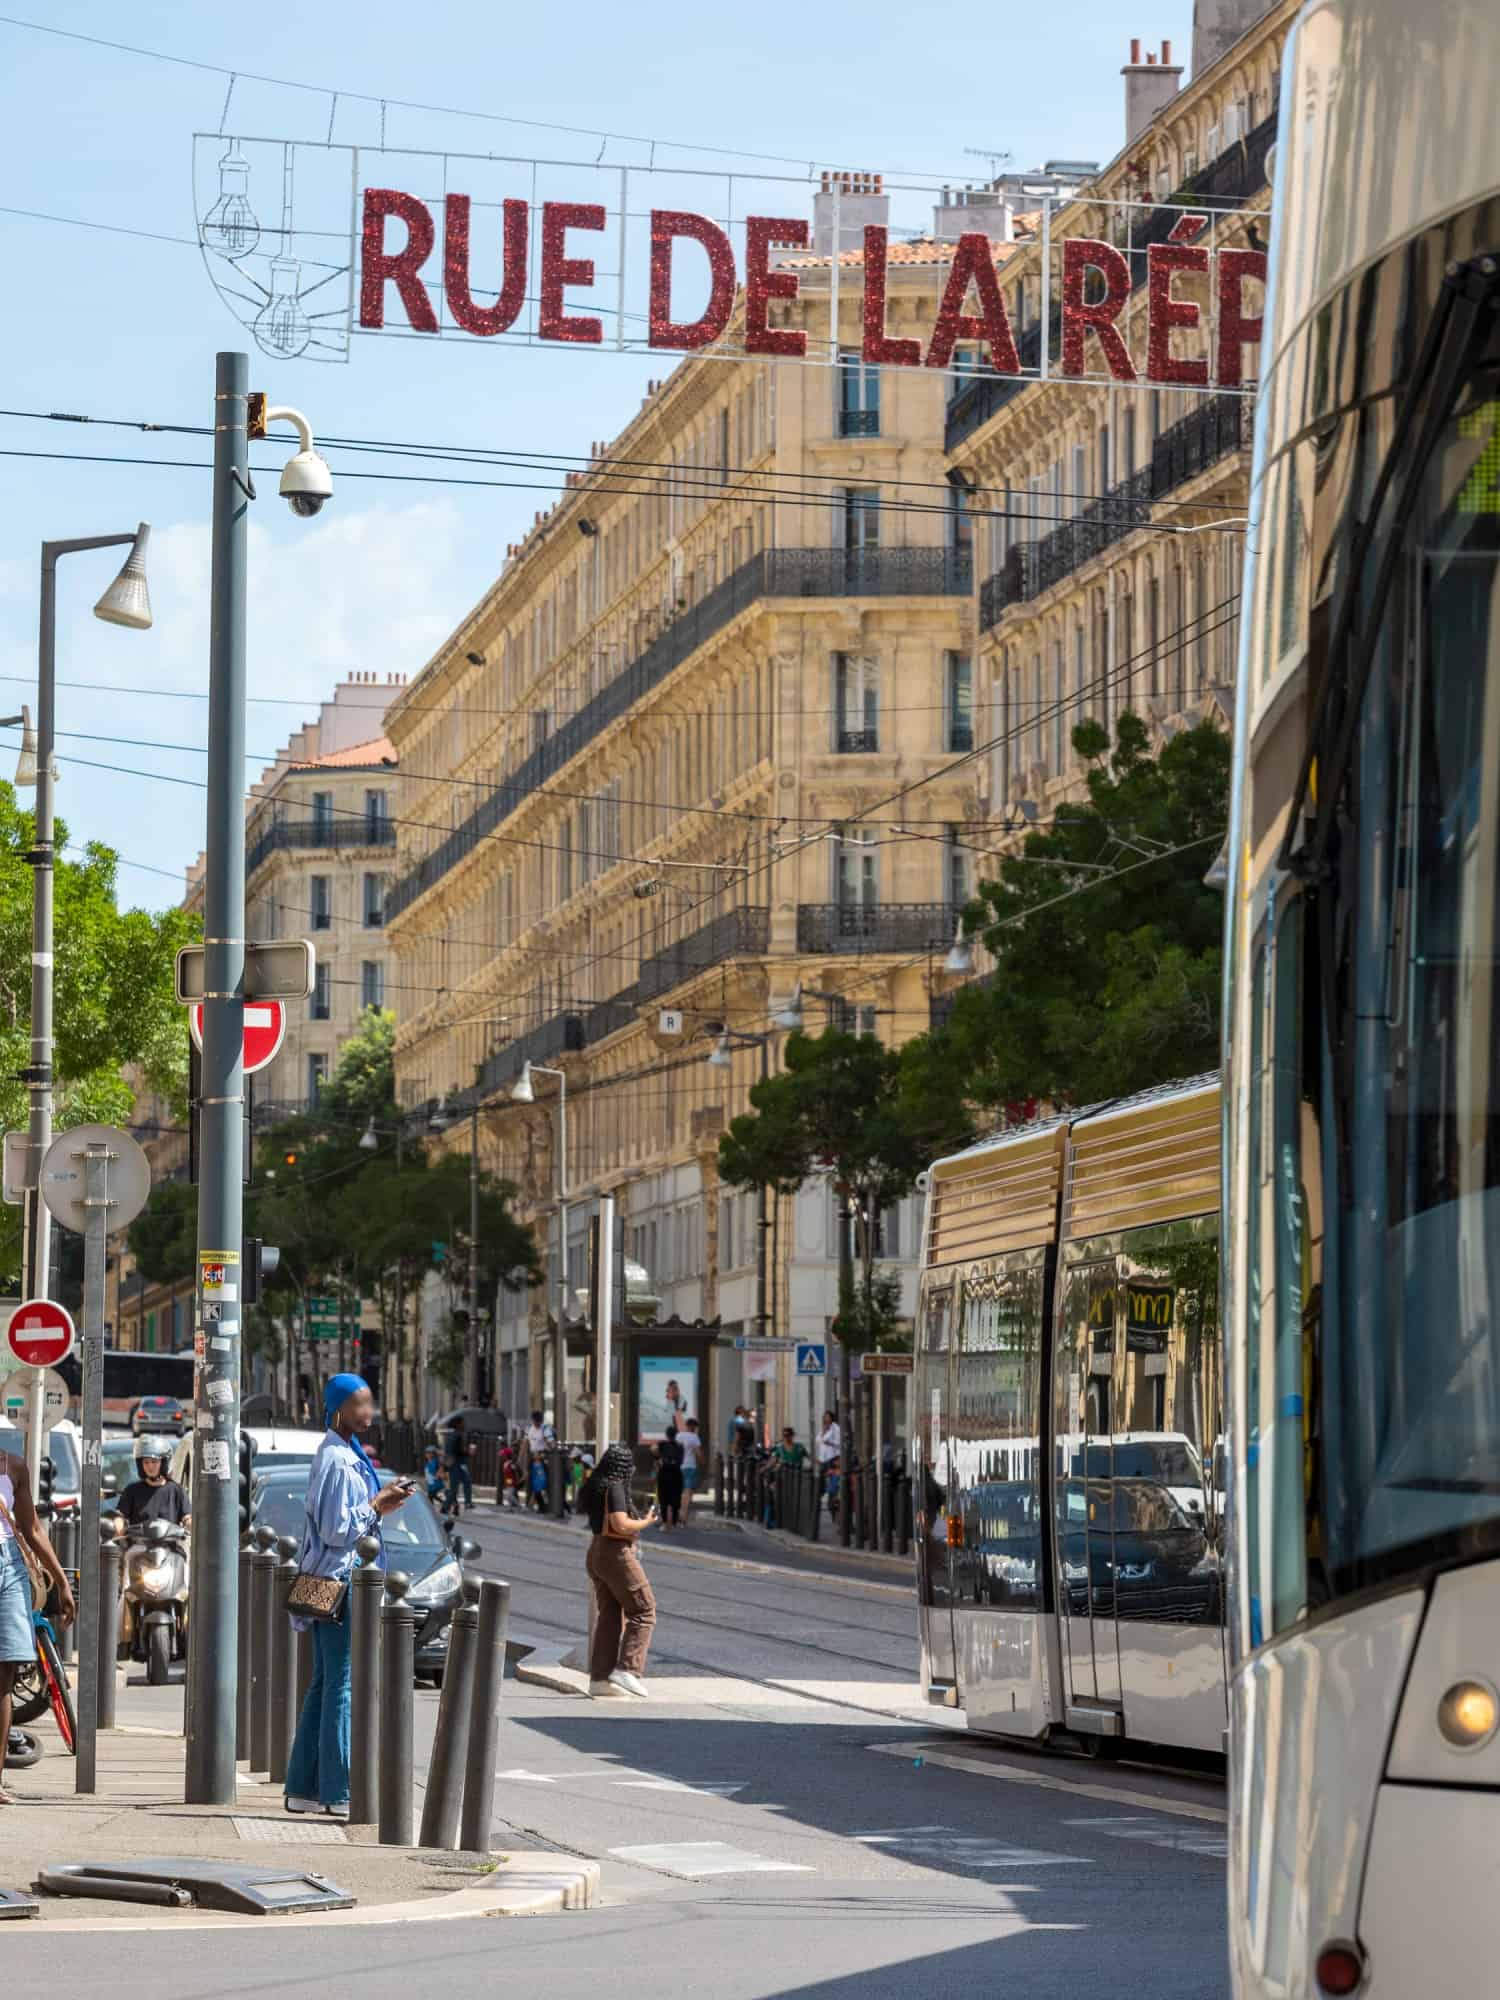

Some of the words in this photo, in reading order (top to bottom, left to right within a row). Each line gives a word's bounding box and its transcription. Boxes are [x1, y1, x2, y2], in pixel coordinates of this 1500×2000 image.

[359, 188, 606, 344] RUE
[648, 209, 809, 357] DE
[861, 223, 1021, 376] LA
